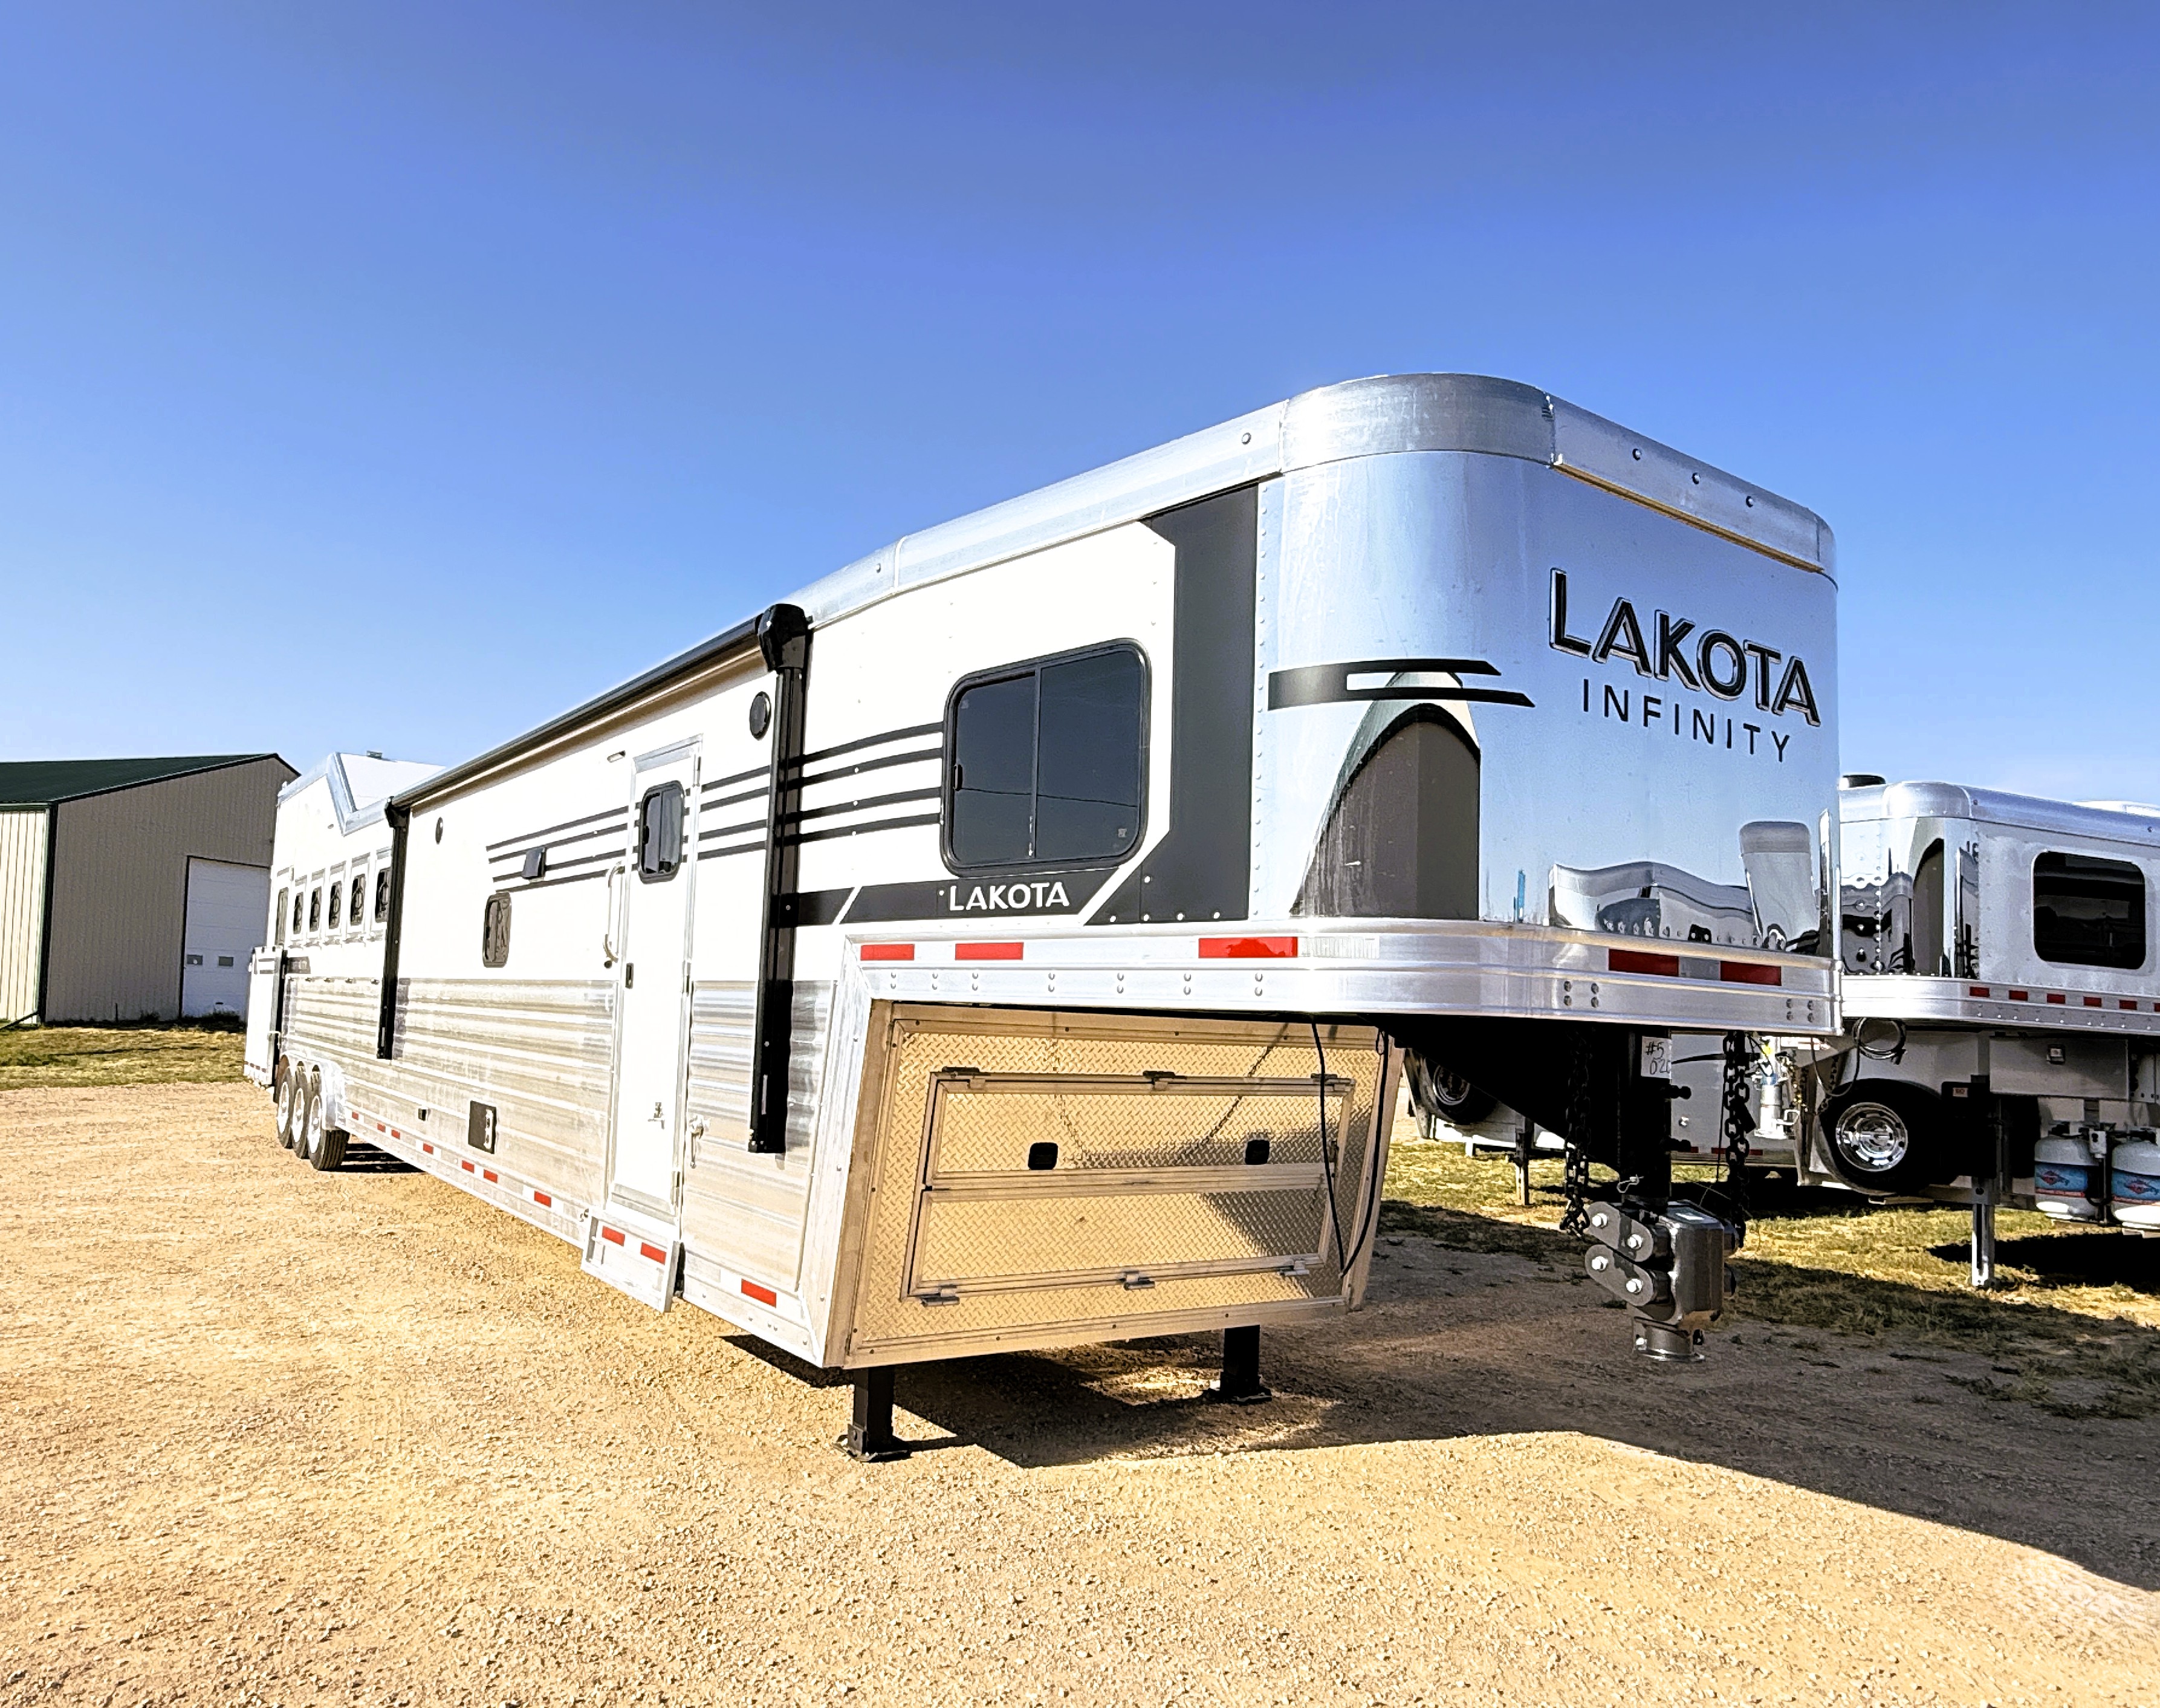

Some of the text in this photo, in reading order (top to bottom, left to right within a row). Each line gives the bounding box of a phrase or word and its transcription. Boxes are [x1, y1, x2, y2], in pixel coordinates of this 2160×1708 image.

[1549, 567, 1821, 727] LAKOTA
[1583, 678, 1791, 762] INFINITY
[949, 881, 1071, 911] LAKOTA
[1645, 1041, 1664, 1060] #5
